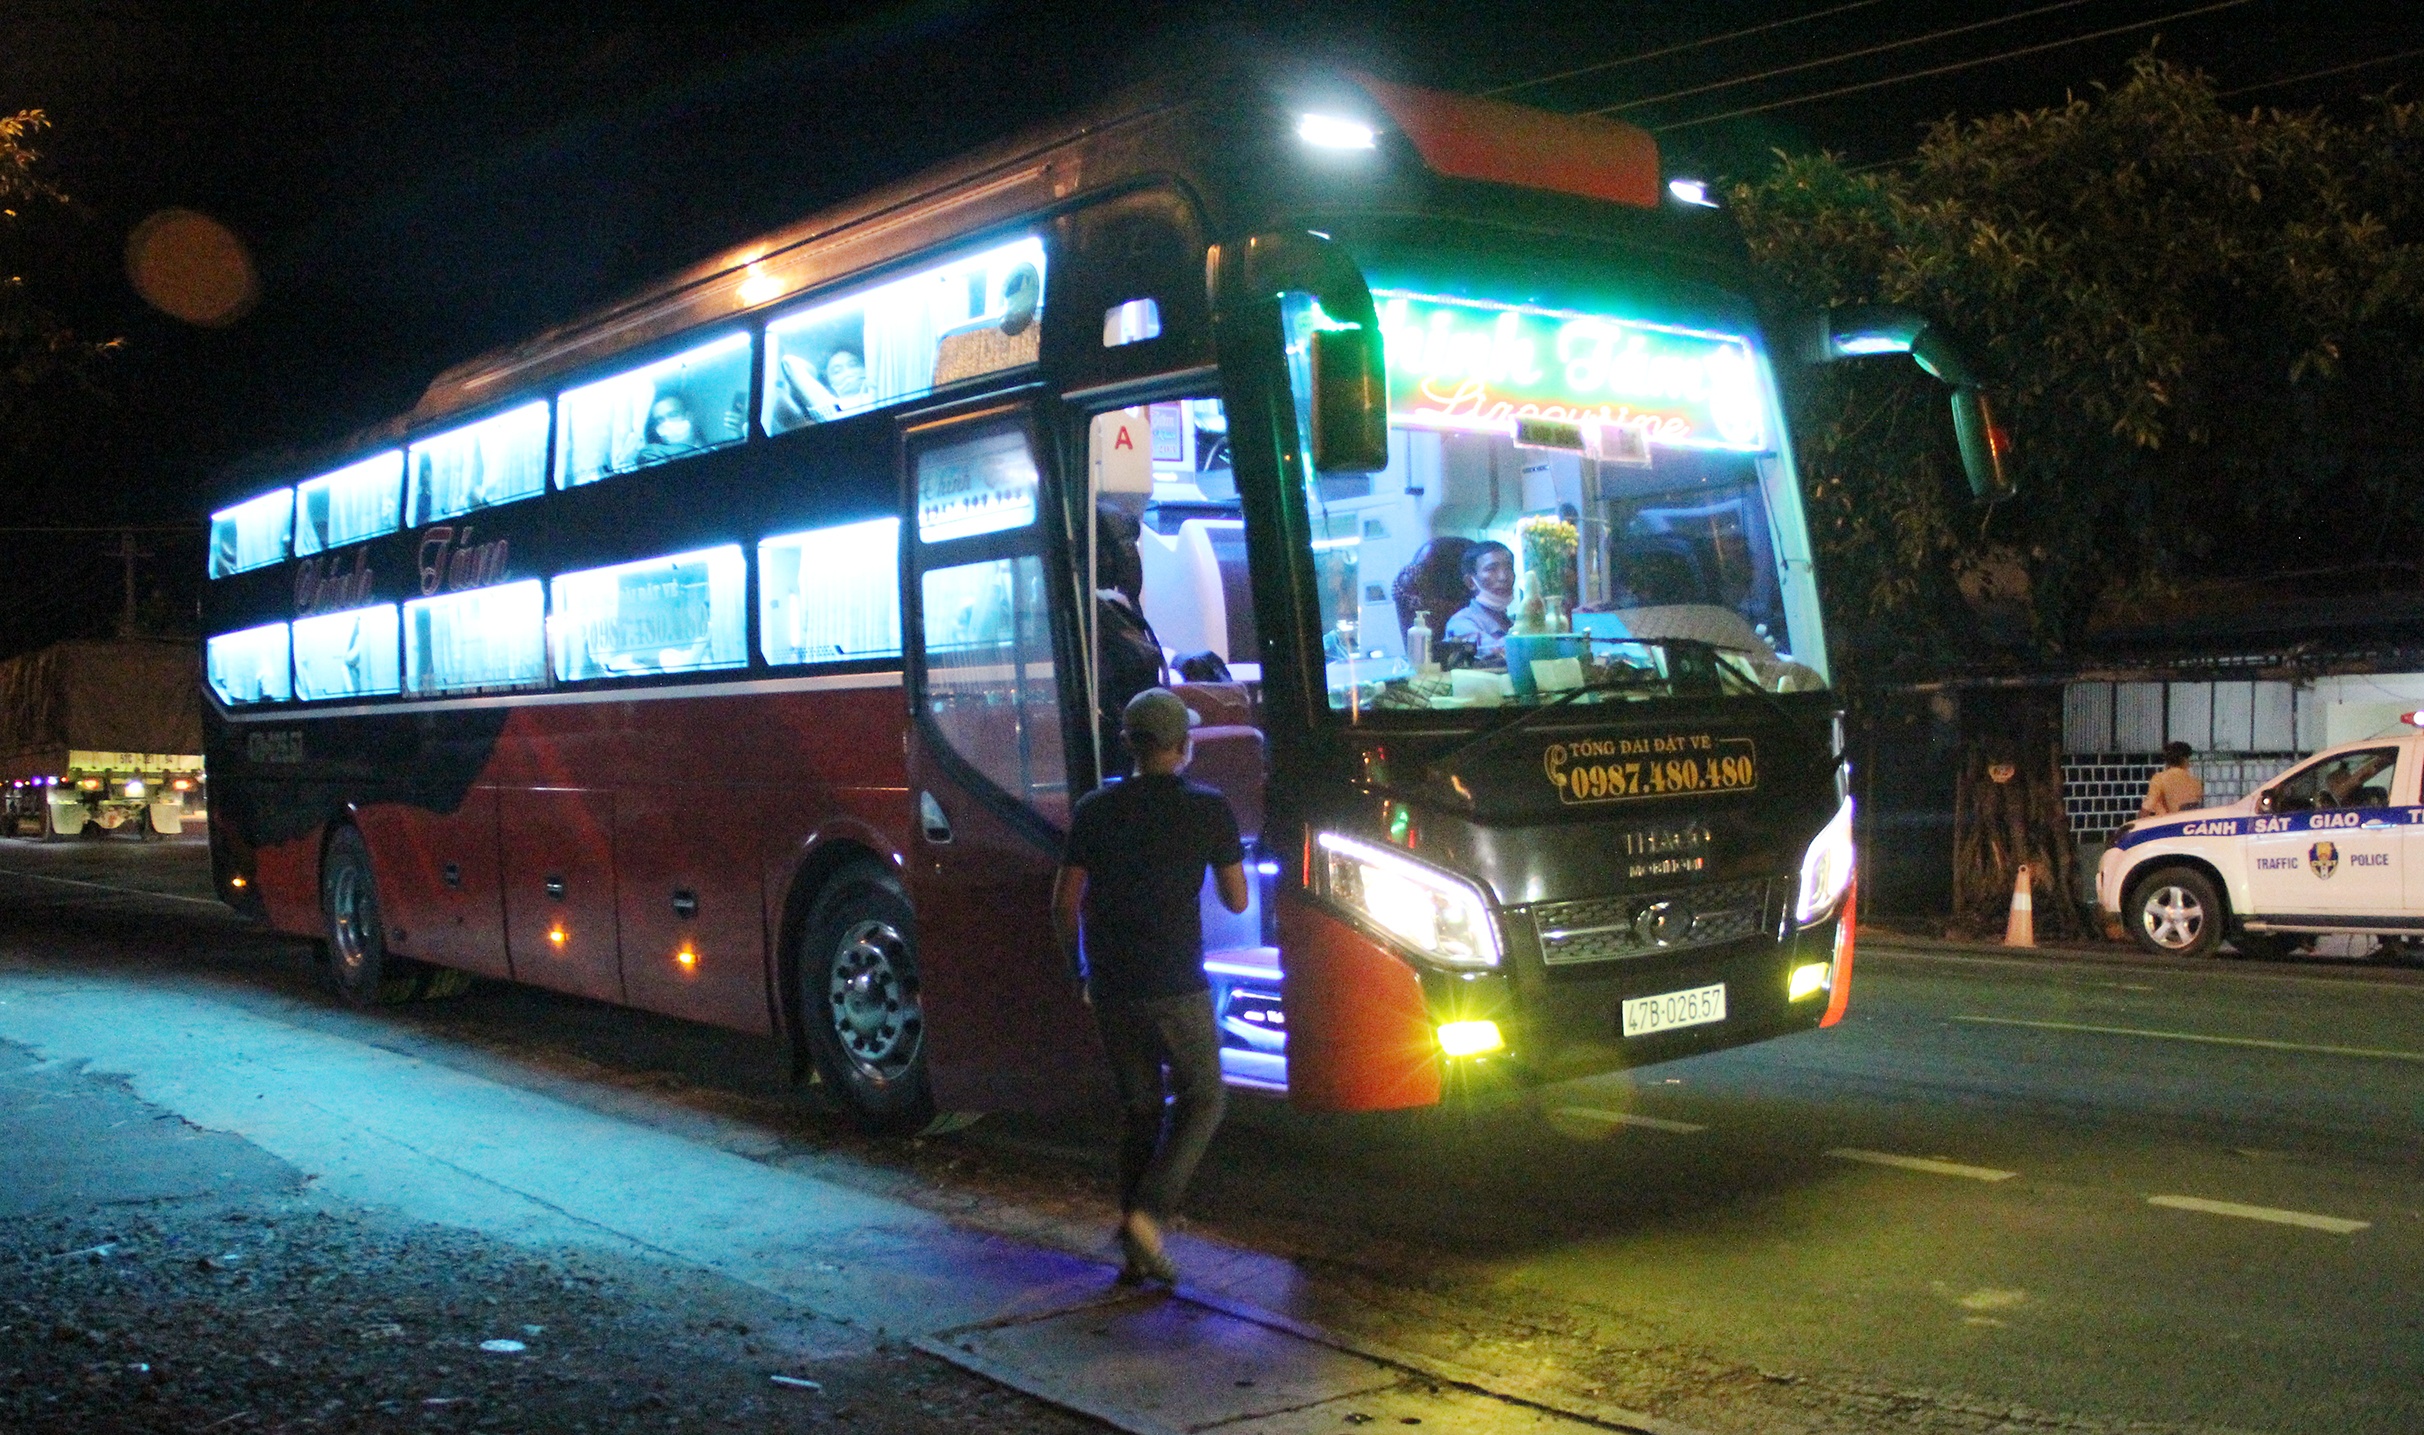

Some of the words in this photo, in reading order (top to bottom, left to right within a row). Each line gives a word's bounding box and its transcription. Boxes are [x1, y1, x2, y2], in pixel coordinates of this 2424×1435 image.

[1115, 426, 1133, 450] A
[1570, 755, 1752, 799] 0987.480.480
[2309, 812, 2360, 829] GIAO
[2257, 857, 2298, 870] TRAFFIC
[2351, 853, 2389, 867] POLICE
[1628, 988, 1720, 1031] 47B-026.57
